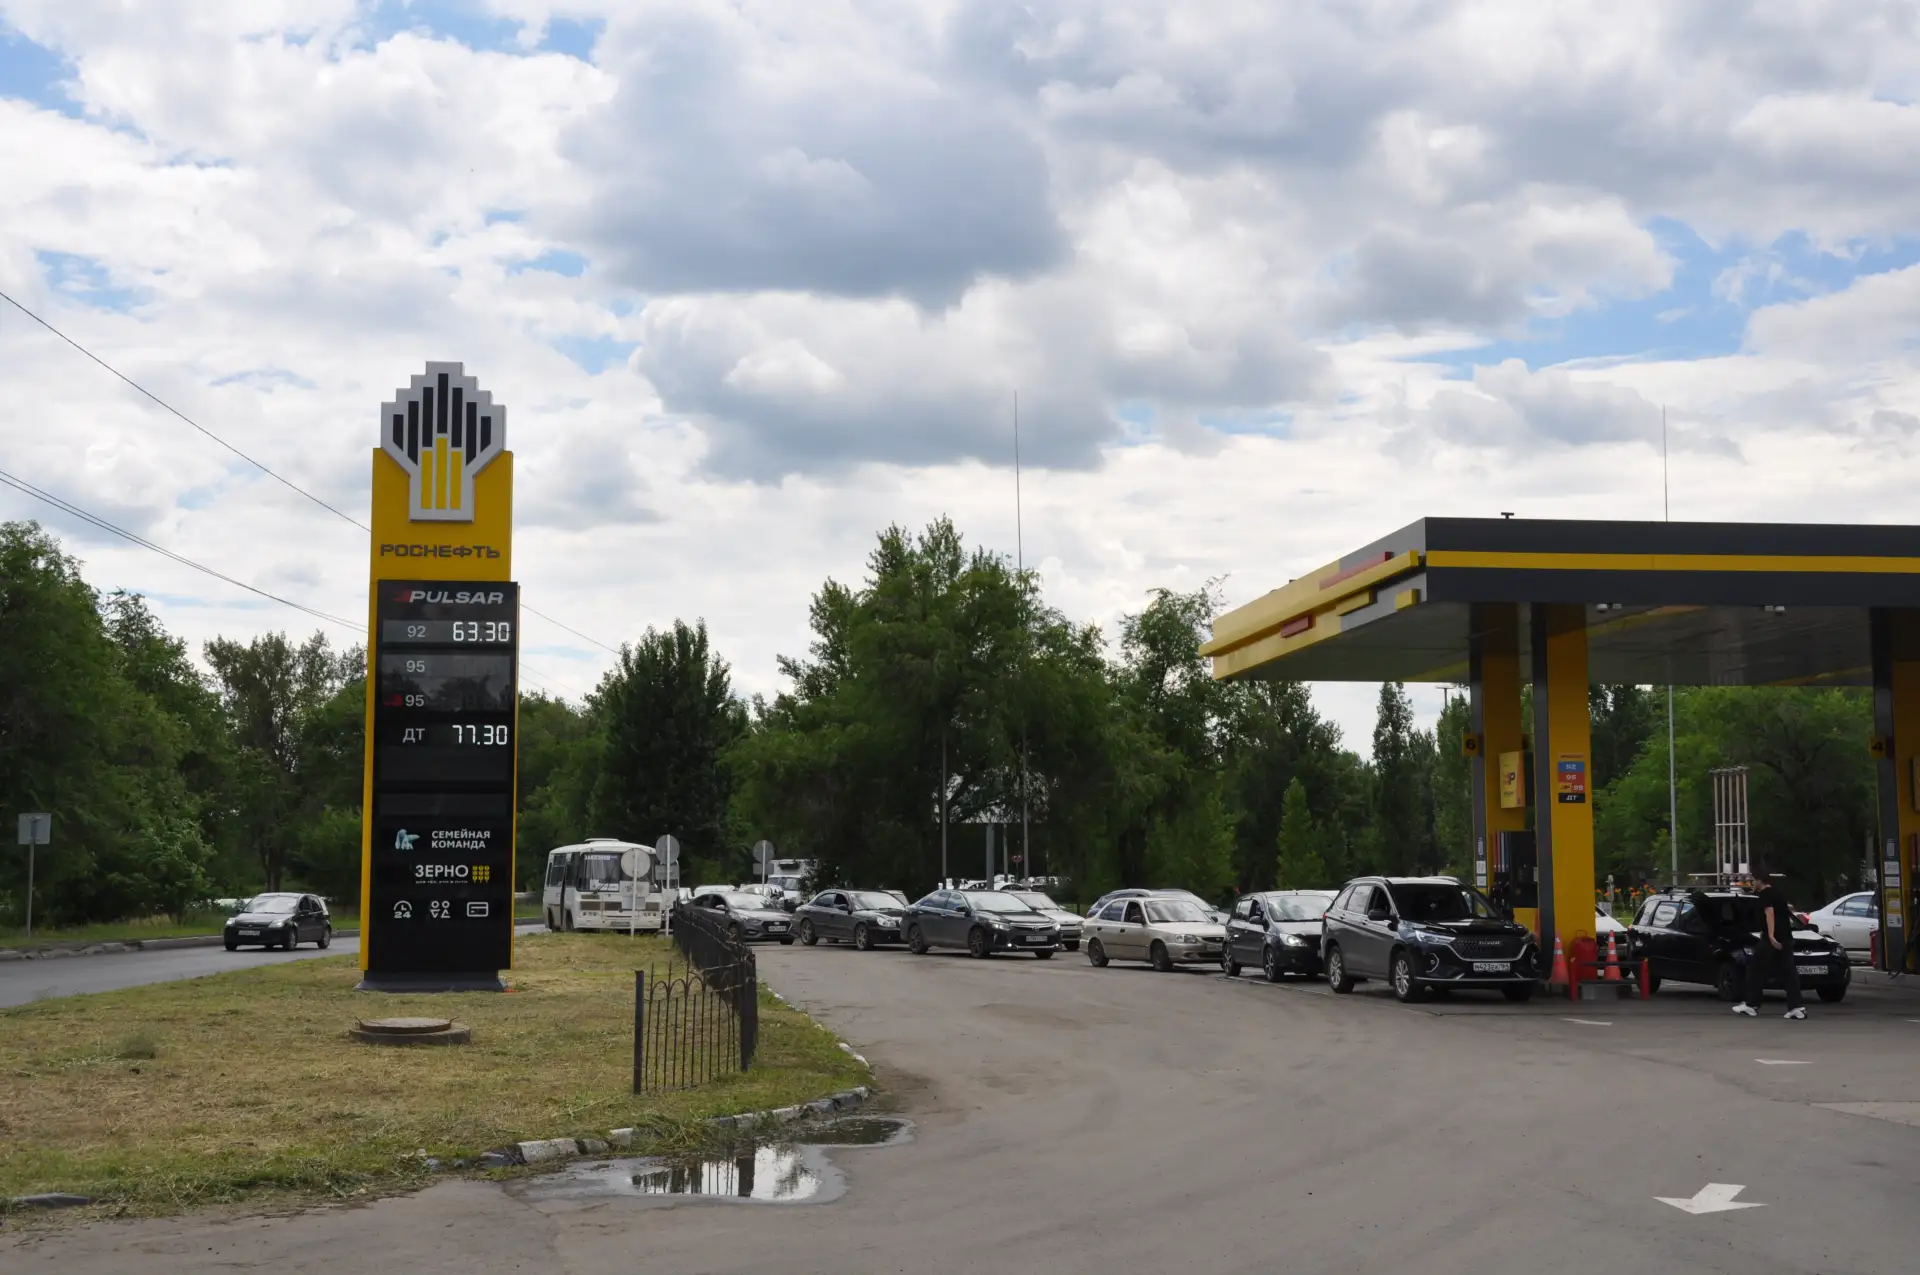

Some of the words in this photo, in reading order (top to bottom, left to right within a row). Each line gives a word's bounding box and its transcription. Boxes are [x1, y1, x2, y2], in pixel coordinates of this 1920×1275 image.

[380, 543, 501, 558] РОСНЕФТЬ
[408, 590, 504, 604] PULSAR
[407, 625, 426, 638] 92
[452, 621, 510, 642] 63.30
[406, 660, 426, 673] 95
[405, 694, 425, 707] 95
[402, 728, 425, 743] ДТ
[452, 724, 508, 745] 77.30
[431, 829, 491, 839] СЕМЕЙНАЯ
[431, 840, 486, 849] КОМАНДА
[415, 864, 469, 878] ЗЕРНО
[394, 911, 412, 919] 24
